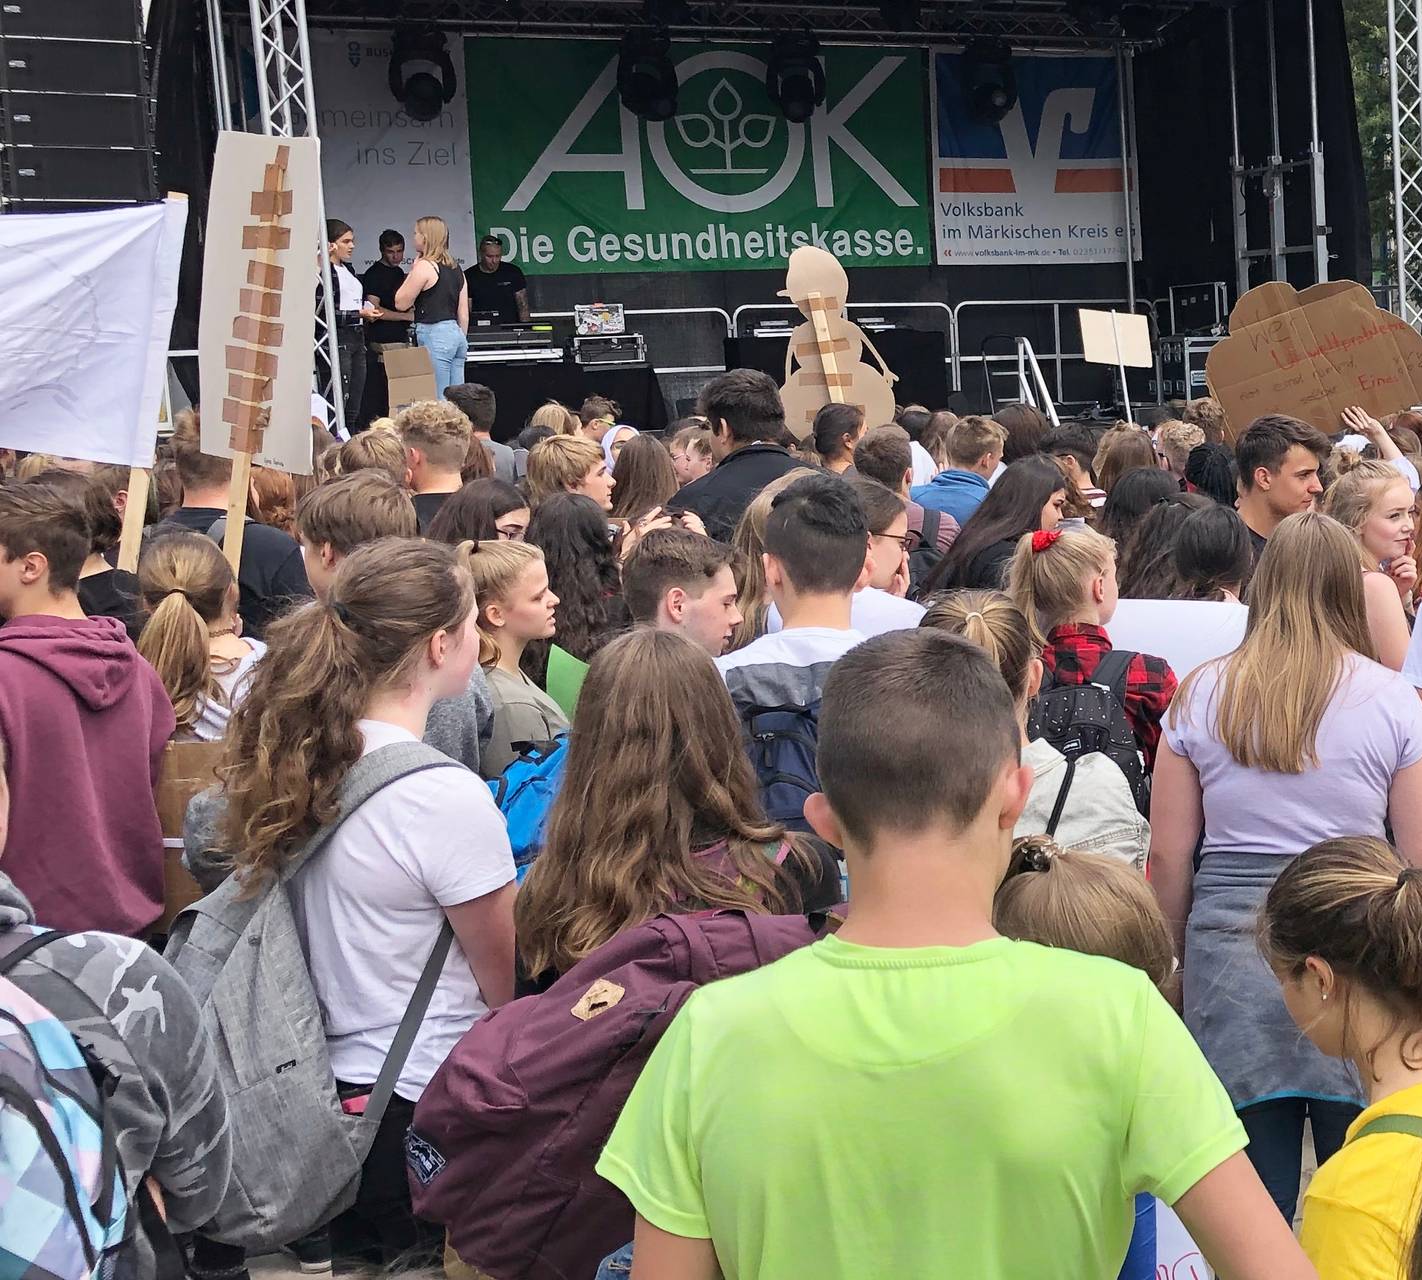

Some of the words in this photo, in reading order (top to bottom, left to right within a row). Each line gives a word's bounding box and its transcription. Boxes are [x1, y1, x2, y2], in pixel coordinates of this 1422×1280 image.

[501, 50, 920, 213] AOK
[355, 142, 396, 166] ins
[407, 141, 457, 167] Ziel
[940, 202, 1025, 217] Volksbank
[489, 225, 554, 264] Die
[567, 222, 925, 264] Gesundheitskasse.
[942, 224, 962, 240] im
[968, 223, 1062, 240] Märkischen
[1068, 223, 1109, 239] Kreis
